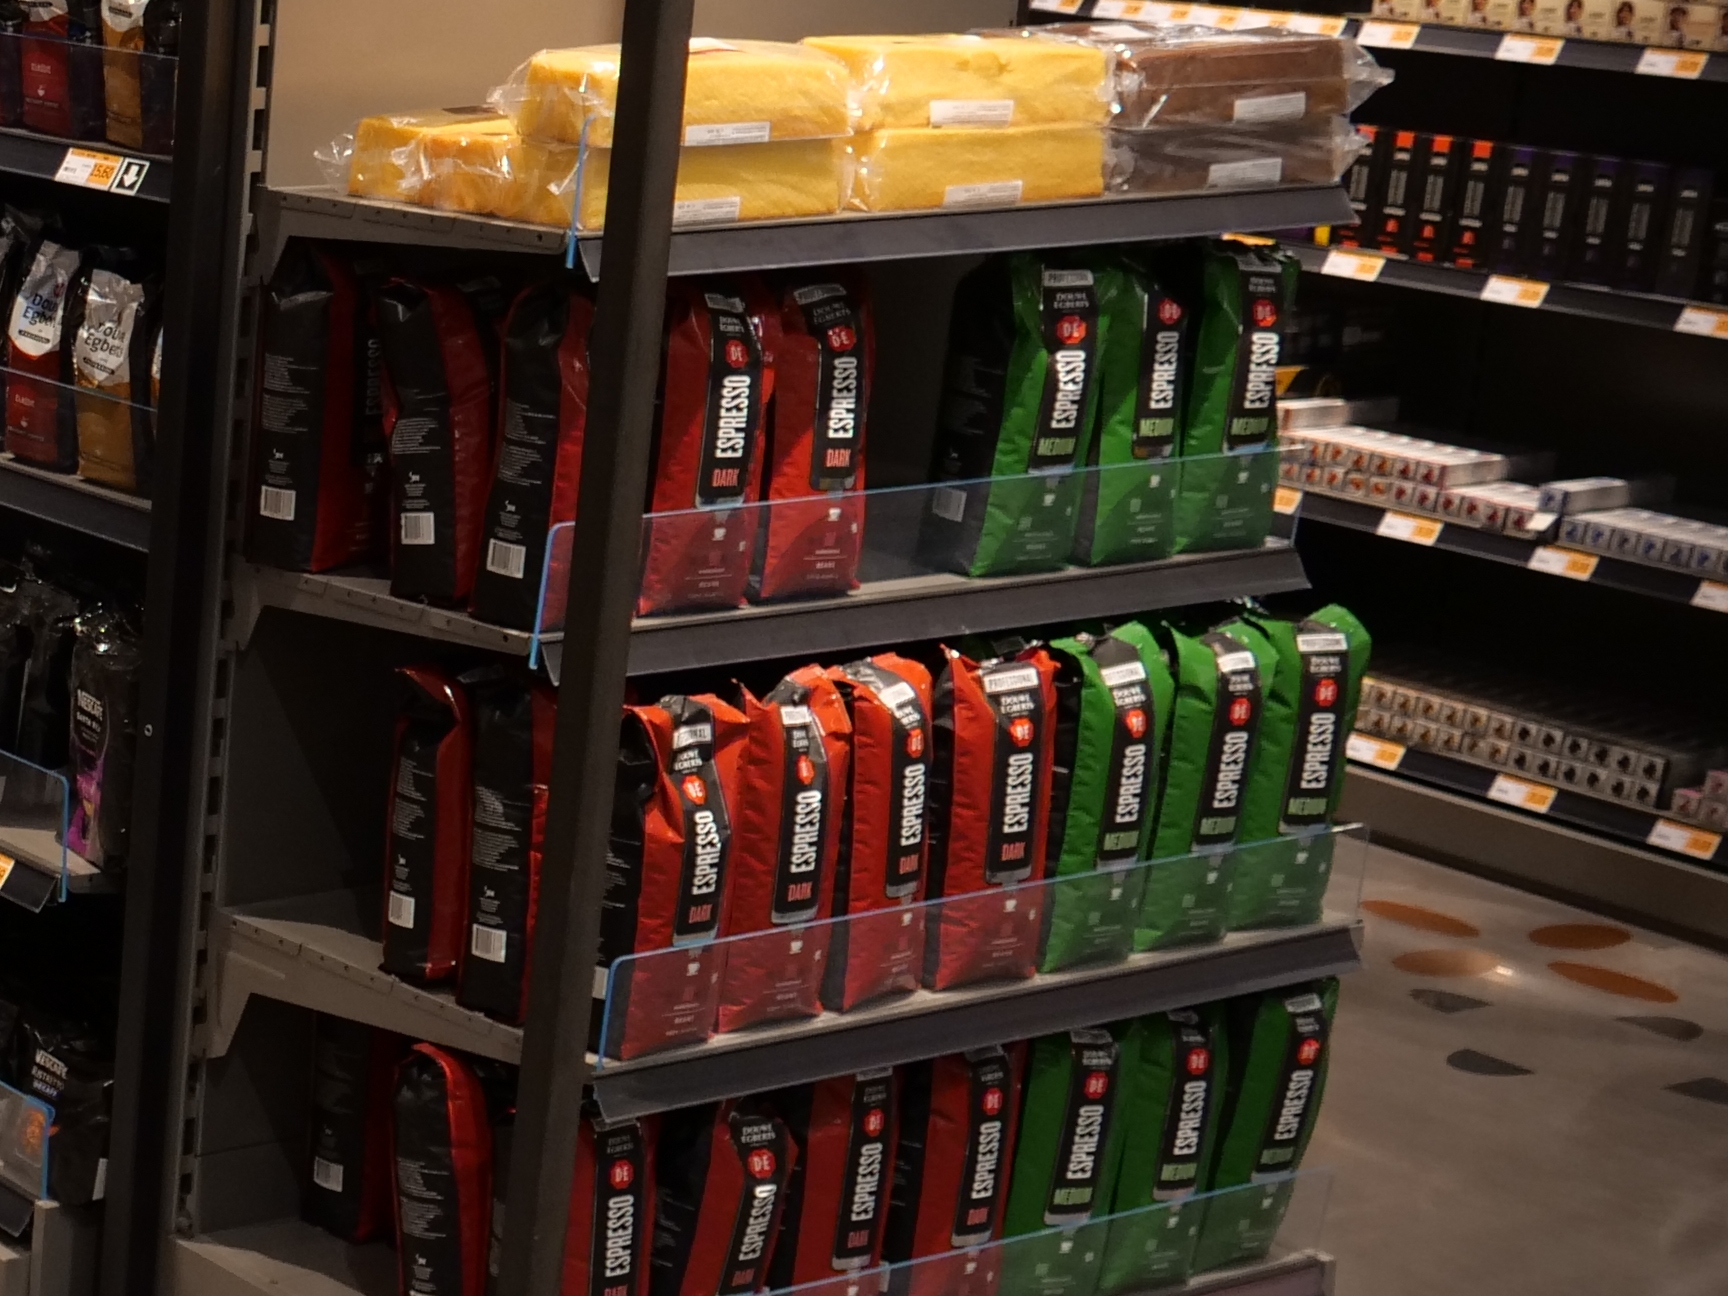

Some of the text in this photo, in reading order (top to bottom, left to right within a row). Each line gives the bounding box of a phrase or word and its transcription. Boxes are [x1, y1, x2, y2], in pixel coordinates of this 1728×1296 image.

[828, 356, 857, 439] ESPRESSO
[1050, 349, 1086, 429] ESPRESSO
[1150, 331, 1180, 409] ESPRESSO
[1244, 332, 1279, 409] ESPRESSO
[715, 374, 751, 459] ESPRESSO
[712, 468, 740, 487] DARK
[825, 448, 851, 467] DARK
[1115, 744, 1146, 824] ESPRESSO
[1213, 731, 1249, 809] ESPRESSO
[1300, 712, 1335, 789] ESPRESSO
[790, 790, 822, 874] ESPRESSO
[900, 763, 925, 847] ESPRESSO
[1003, 752, 1034, 834] ESPRESSO
[691, 810, 722, 895] ESPRESSO
[1001, 842, 1026, 861] DARK
[787, 881, 813, 901] DARK
[1066, 1105, 1104, 1180] ESPRESSO
[1173, 1080, 1207, 1155] ESPRESSO
[1274, 1069, 1314, 1140] ESPRESSO
[851, 1142, 883, 1221] ESPRESSO
[971, 1121, 1002, 1199] ESPRESSO
[605, 1194, 635, 1278] ESPRESSO
[739, 1183, 777, 1261] ESPRESSO
